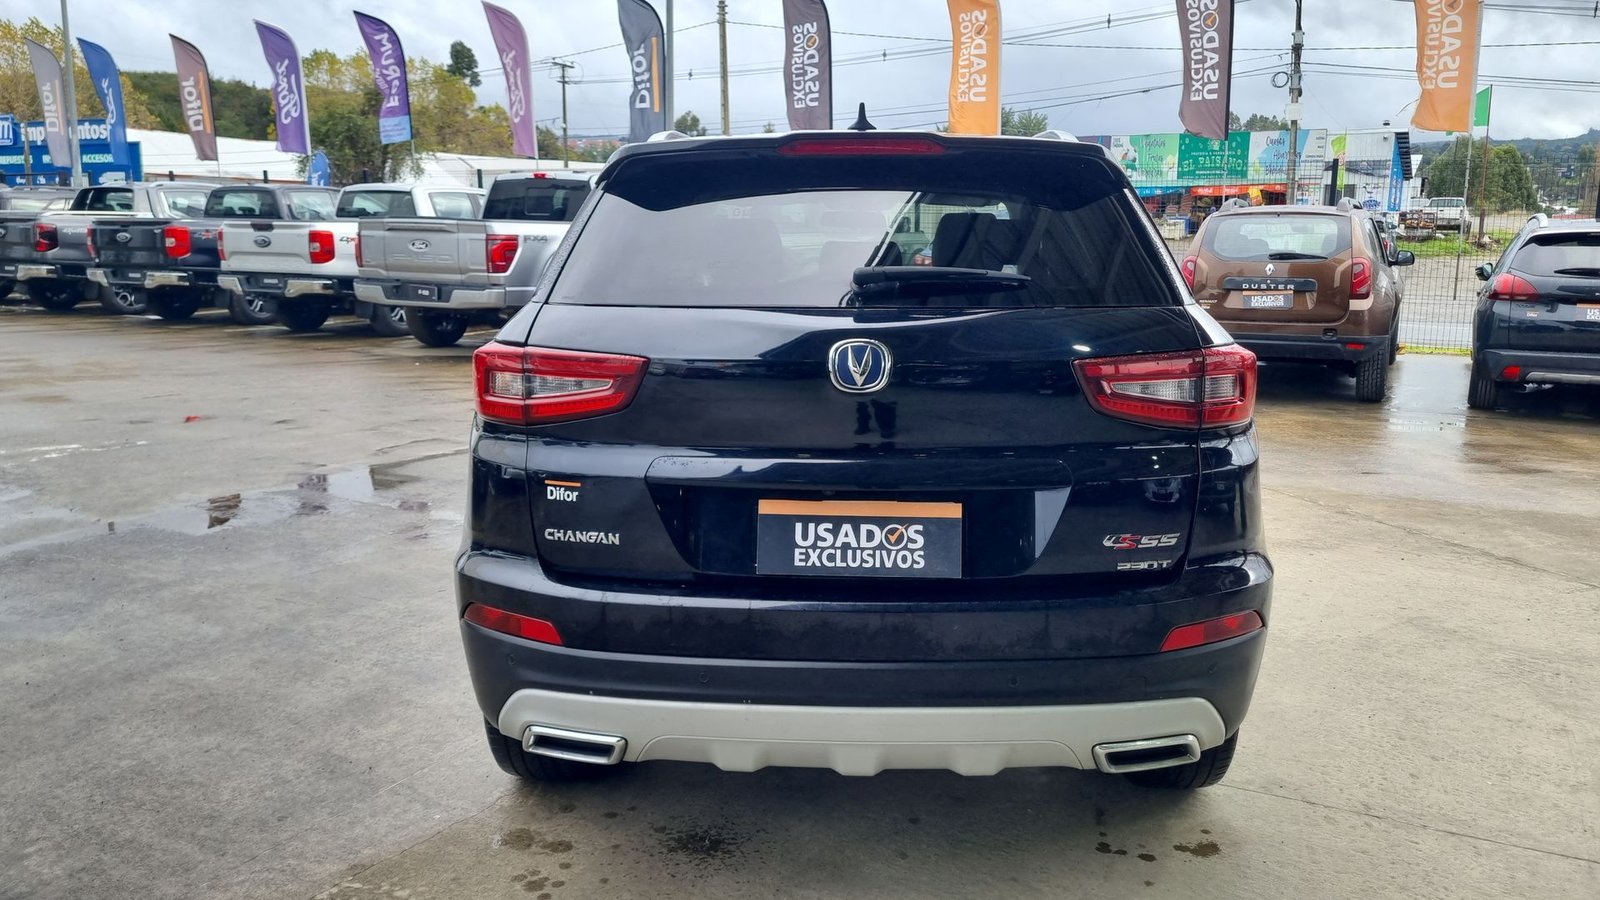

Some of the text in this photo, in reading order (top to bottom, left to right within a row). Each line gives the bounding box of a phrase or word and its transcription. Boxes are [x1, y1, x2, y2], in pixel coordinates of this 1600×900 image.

[82, 153, 114, 163] ACCESOR
[1251, 294, 1284, 302] USADOS
[547, 486, 579, 501] Difor
[544, 528, 620, 545] CHANGAN
[794, 522, 925, 550] USADOS
[794, 548, 925, 569] EXCLUSIVOS
